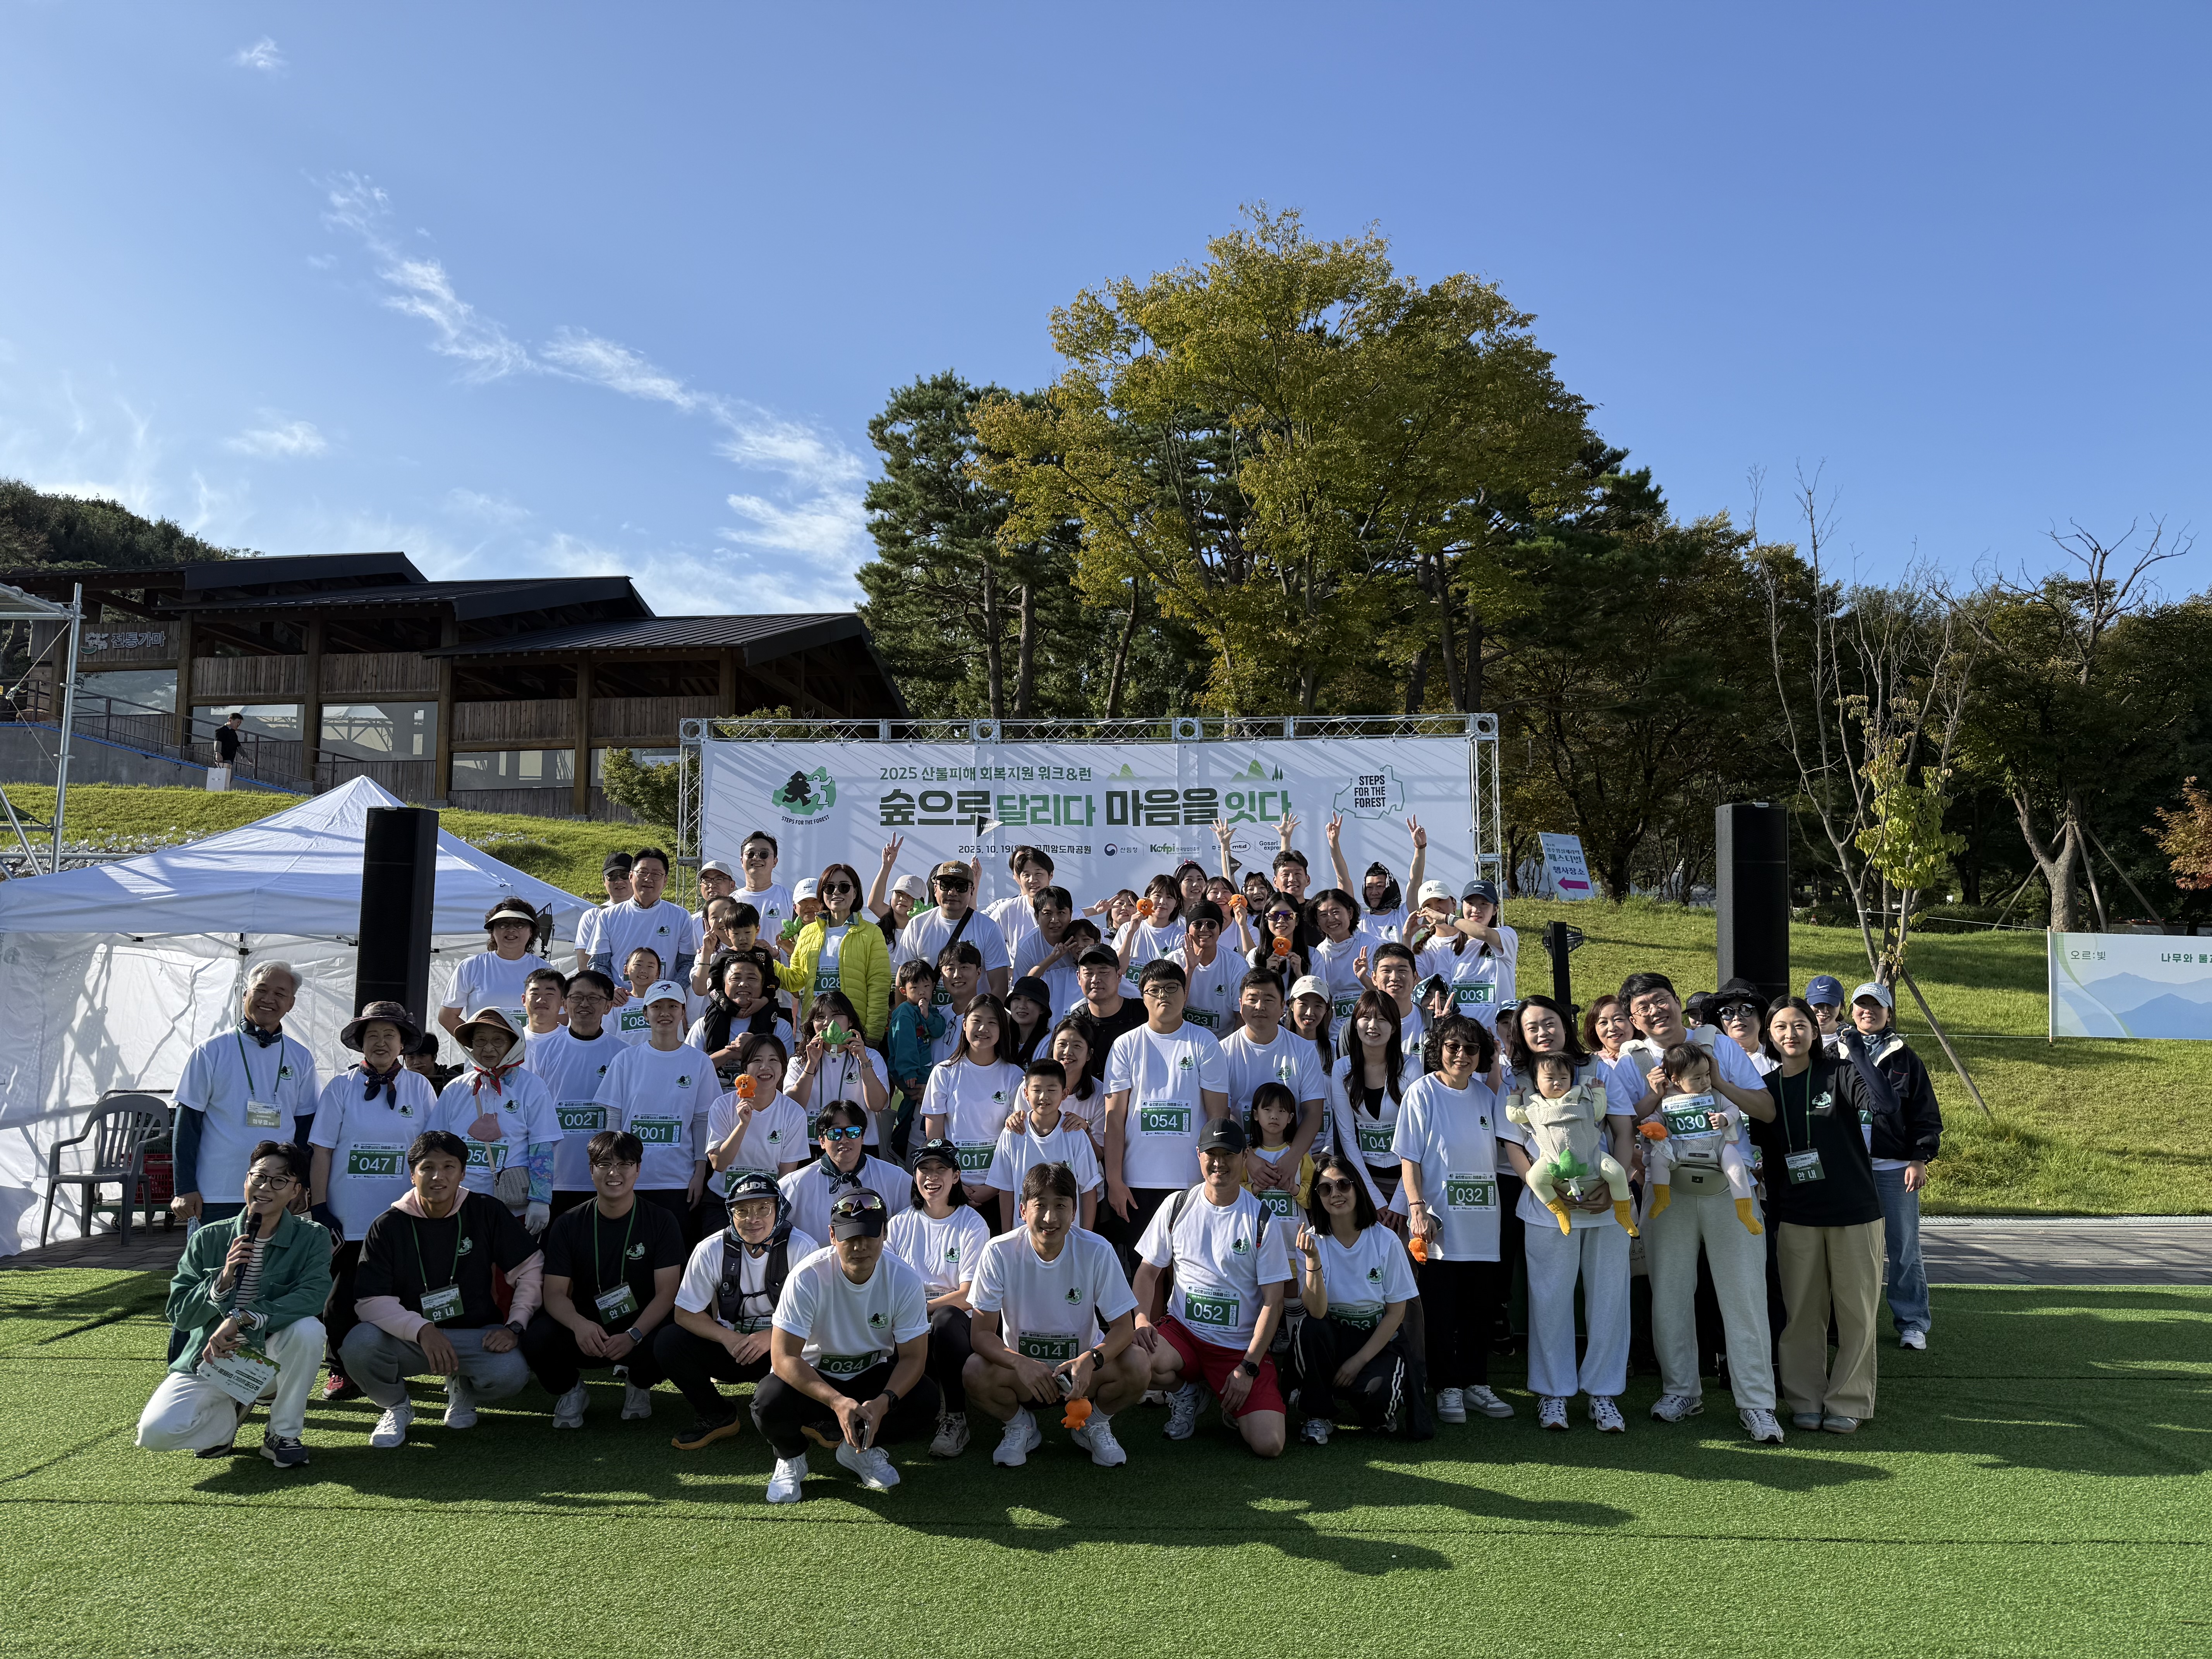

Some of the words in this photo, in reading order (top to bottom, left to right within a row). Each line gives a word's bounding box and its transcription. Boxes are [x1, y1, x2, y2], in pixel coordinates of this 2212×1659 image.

[111, 631, 166, 648] 전통가마
[880, 767, 917, 780] 2025
[922, 767, 976, 781] 산불피해
[980, 766, 1034, 781] 회복지원
[1038, 767, 1091, 781] 워크&런
[1359, 775, 1385, 785] STEPS
[1354, 787, 1369, 796] FOR
[1371, 786, 1385, 795] THE
[1355, 797, 1386, 808] FOREST
[814, 814, 830, 824] FOREST
[1150, 843, 1175, 855] Kofpi
[1553, 866, 1585, 875] 행사장소
[2161, 953, 2193, 963] 나무와
[938, 993, 951, 1003] 07
[1460, 990, 1484, 1001] 003
[1341, 1003, 1354, 1015] 00
[1187, 1013, 1207, 1025] 023
[564, 1114, 592, 1126] 002
[1149, 1114, 1178, 1128] 054
[1676, 1114, 1706, 1131] 030
[639, 1127, 665, 1140] 001
[359, 1157, 390, 1171] 047
[962, 1153, 988, 1167] 017
[737, 1182, 767, 1194] GLIDE
[1456, 1187, 1483, 1202] 032
[1193, 1302, 1223, 1321] 052
[1029, 1343, 1063, 1357] 014
[830, 1359, 864, 1372] 034
